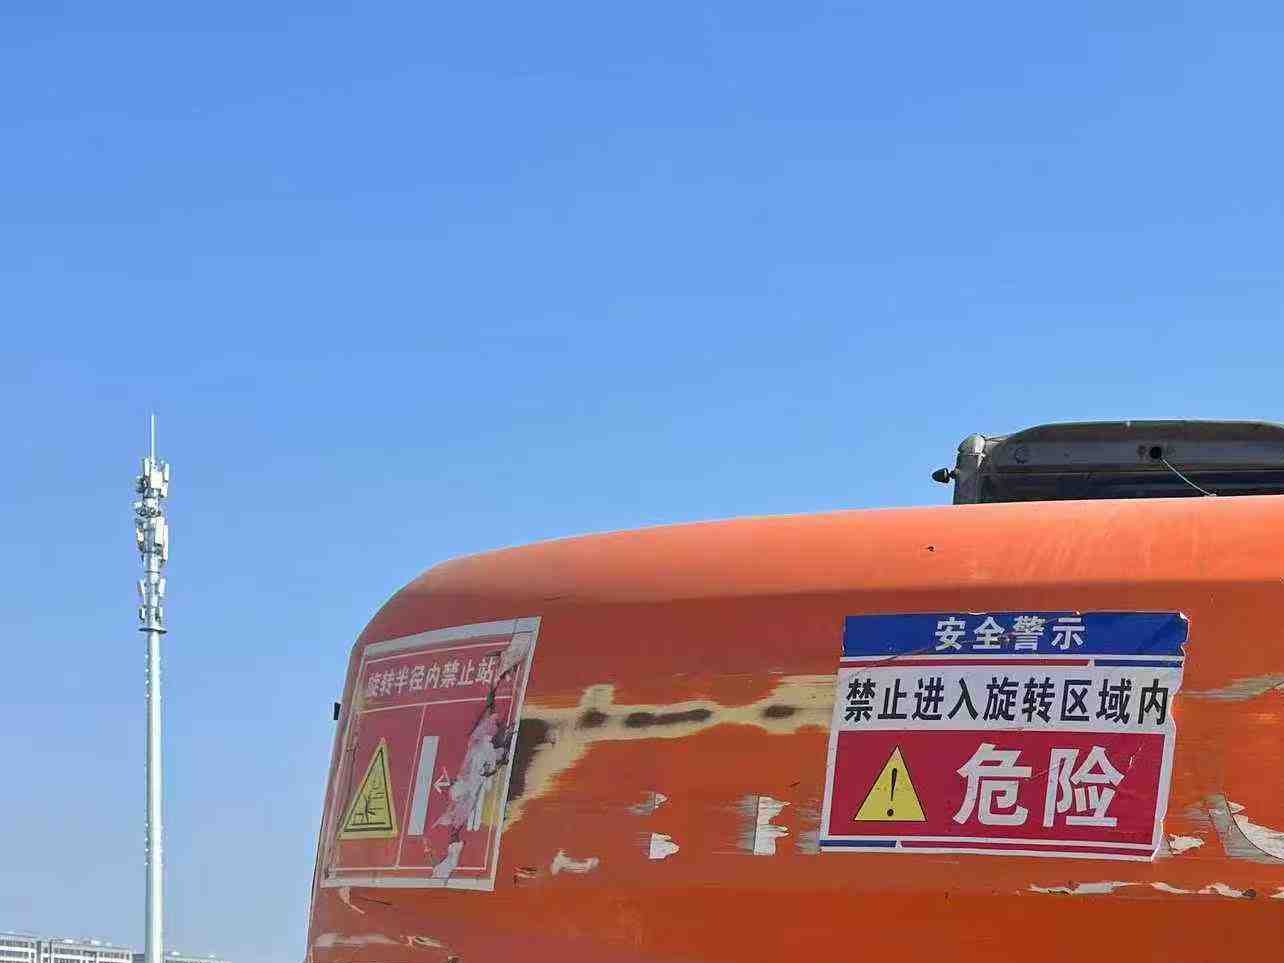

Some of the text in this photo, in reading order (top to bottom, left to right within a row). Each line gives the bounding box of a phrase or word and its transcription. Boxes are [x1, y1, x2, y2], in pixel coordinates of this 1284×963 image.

[935, 616, 1086, 651] 安全警示
[367, 656, 512, 696] 旋转半径内禁止站
[844, 677, 1170, 725] 禁止进入旋转区域内
[952, 742, 1125, 828] 危险
